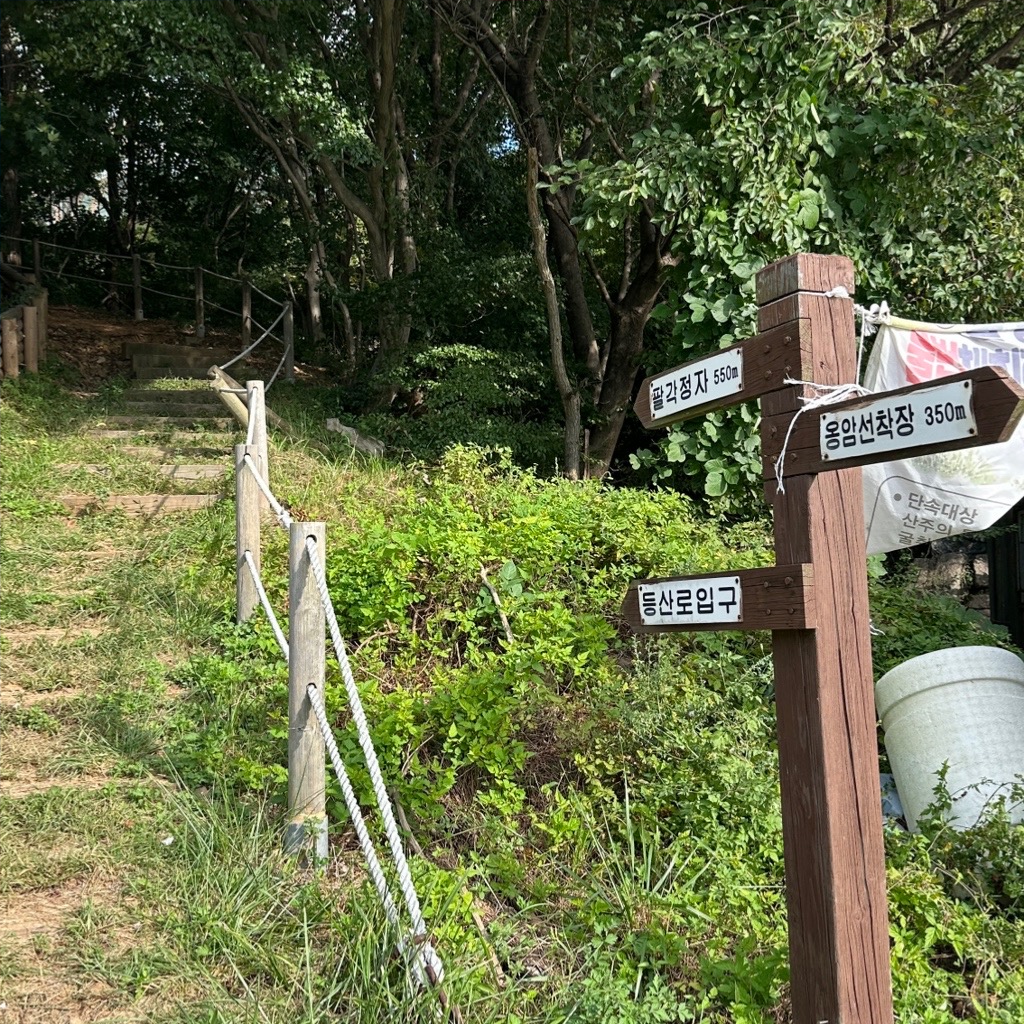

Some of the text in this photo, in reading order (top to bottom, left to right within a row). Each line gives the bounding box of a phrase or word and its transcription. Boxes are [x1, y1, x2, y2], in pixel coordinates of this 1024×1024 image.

[652, 365, 739, 411] 팔각정자 550m
[825, 401, 967, 451] 옹암선착장 350m
[902, 513, 953, 537] 산주의
[907, 492, 979, 526] 단속대상
[642, 587, 737, 617] 등산로입구
